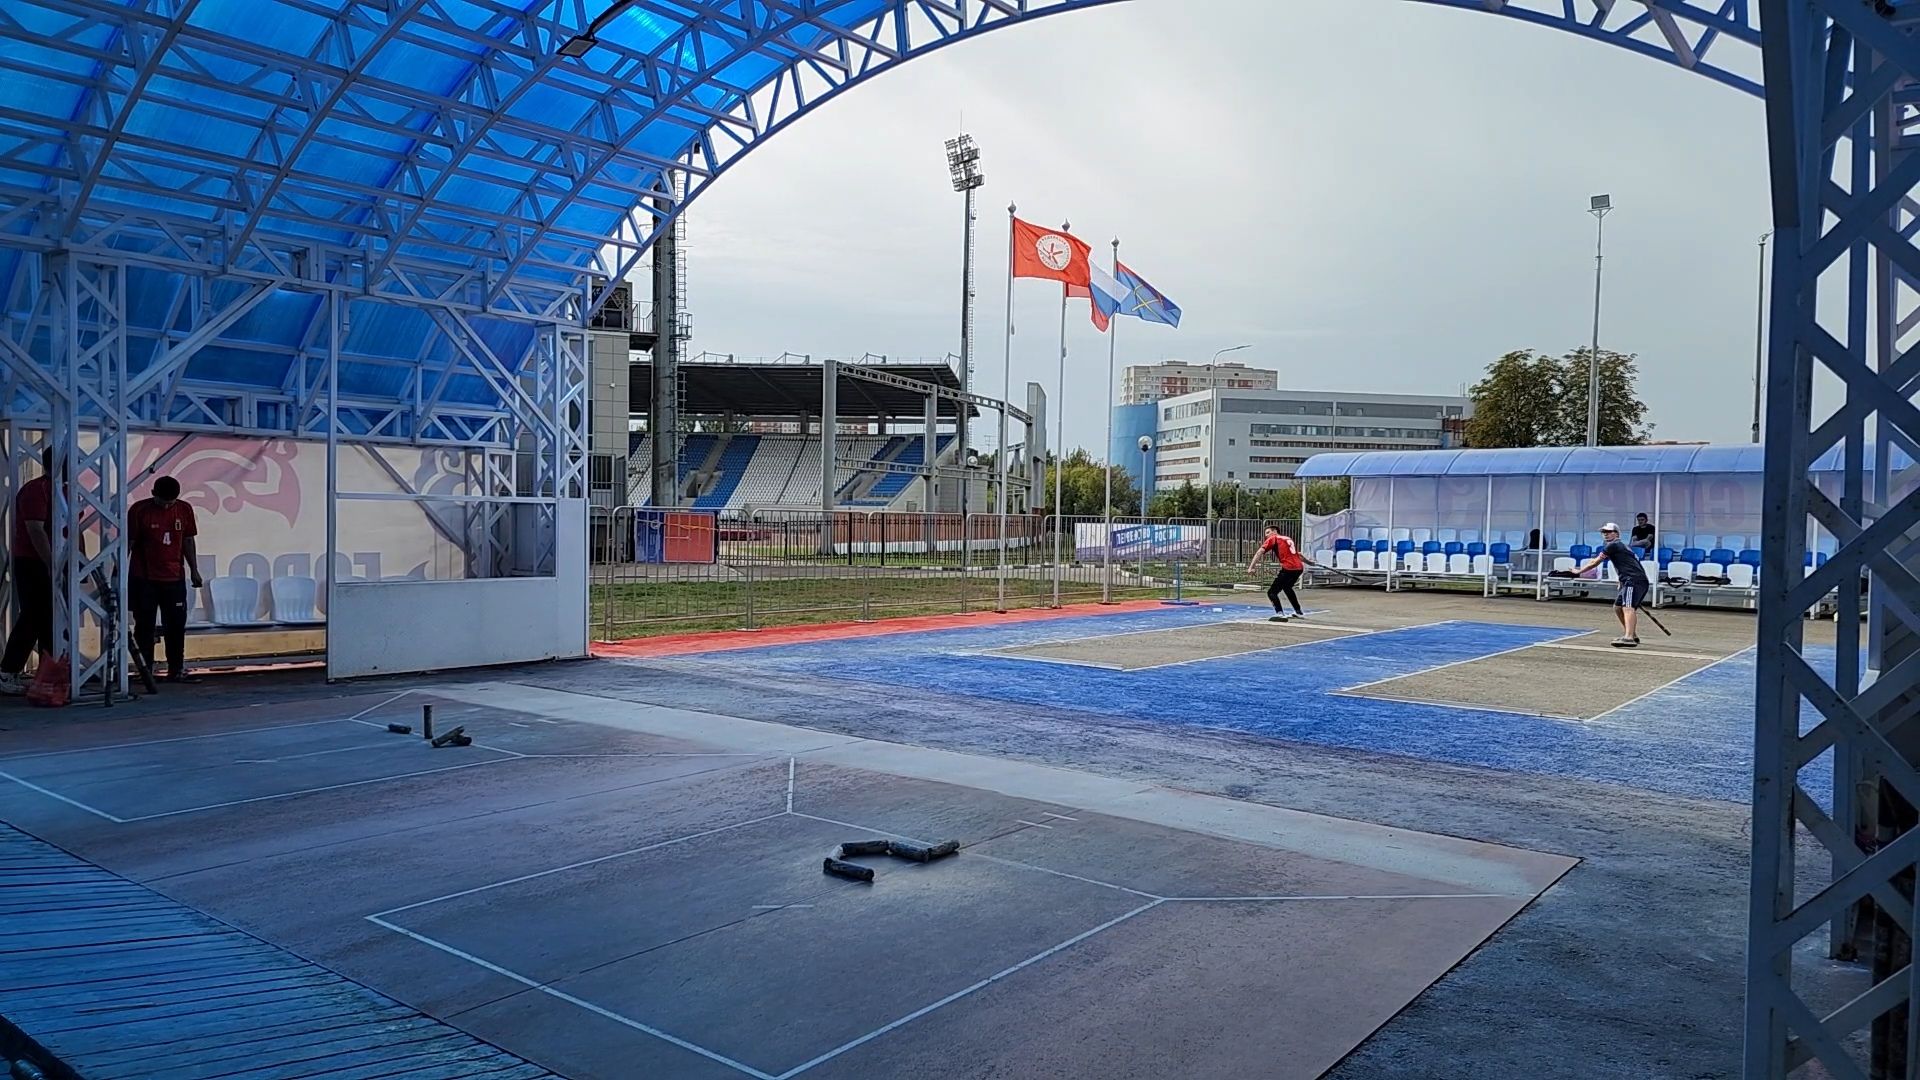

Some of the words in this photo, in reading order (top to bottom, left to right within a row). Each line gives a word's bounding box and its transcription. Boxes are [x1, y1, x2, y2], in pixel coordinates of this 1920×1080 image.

[162, 531, 172, 546] 4
[1115, 527, 1151, 545] ПЕВЕНСВО
[1154, 527, 1177, 543] РОСИИ
